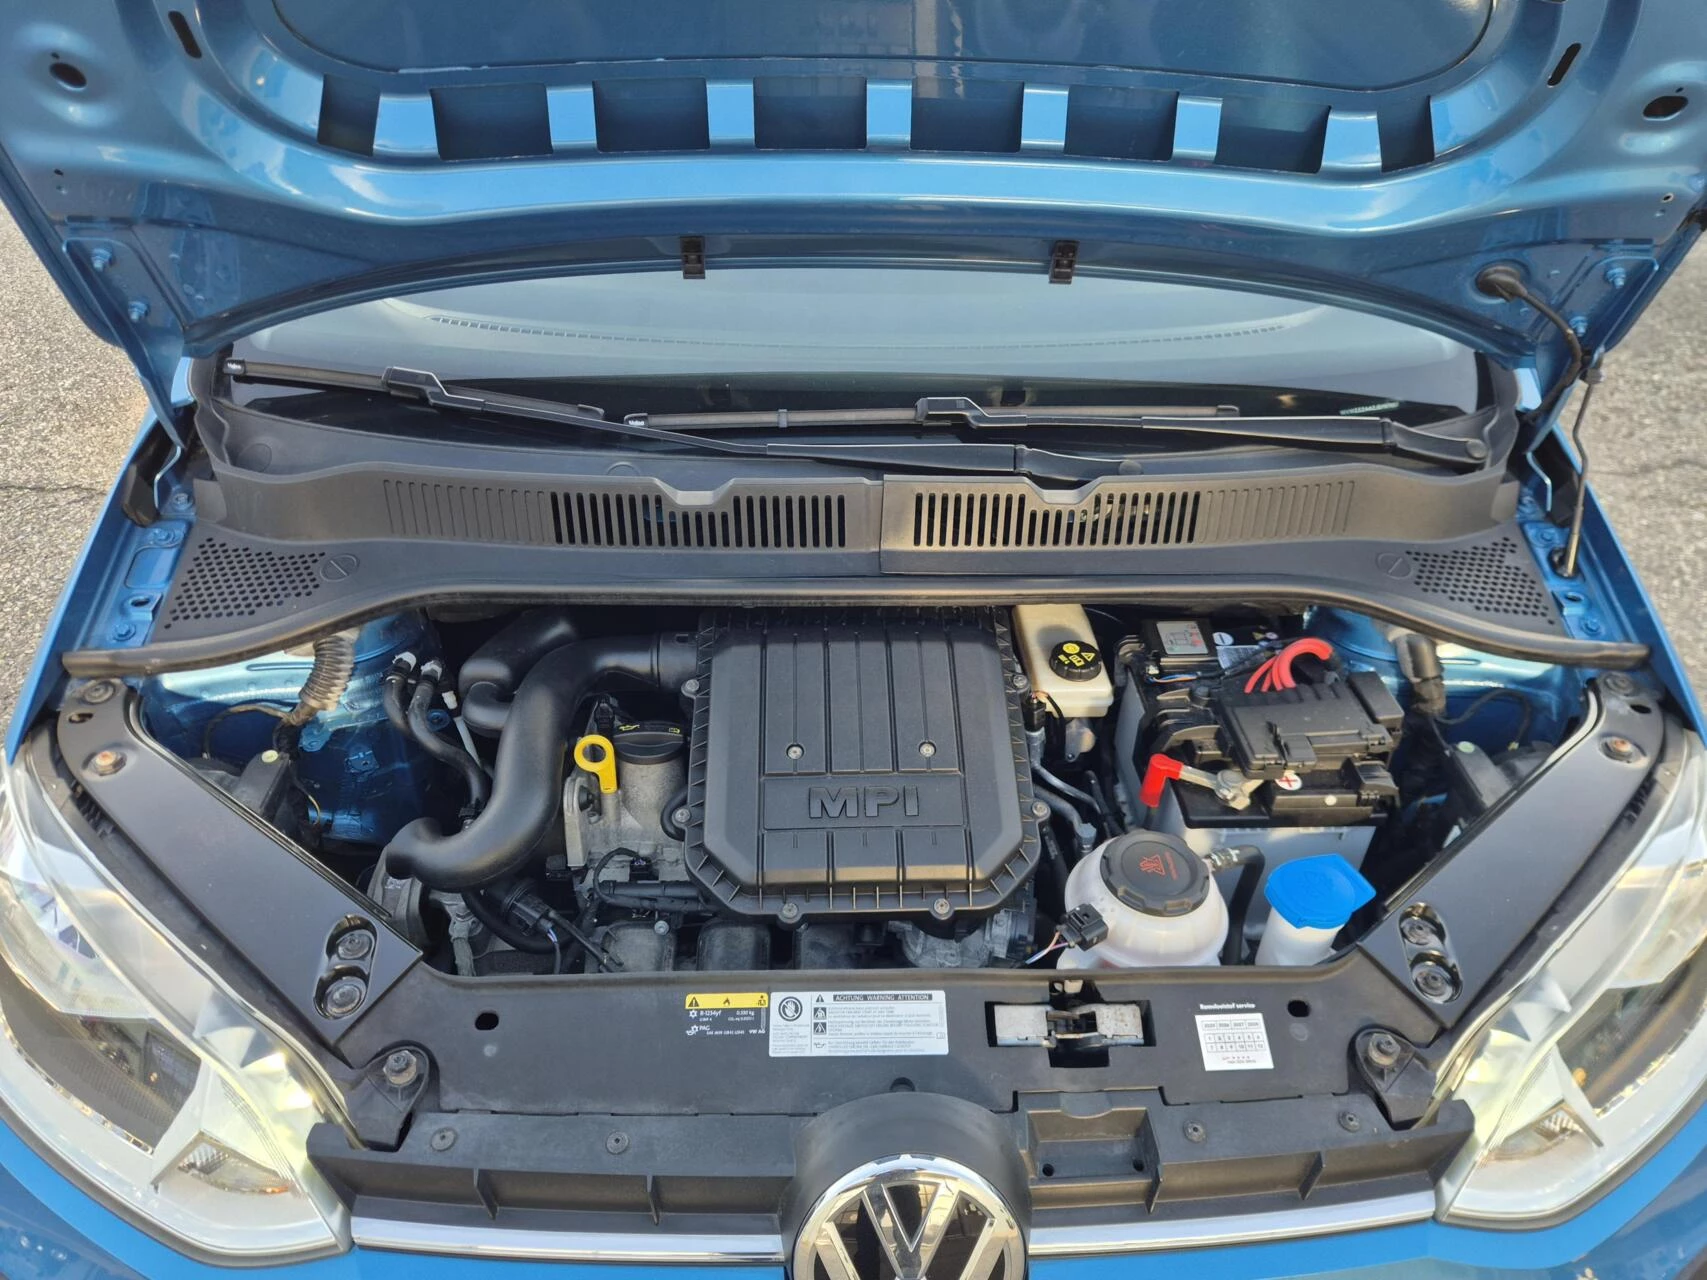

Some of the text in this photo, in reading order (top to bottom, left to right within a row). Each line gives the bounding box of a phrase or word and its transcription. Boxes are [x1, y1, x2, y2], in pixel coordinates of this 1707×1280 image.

[808, 784, 920, 819] MPI
[866, 993, 895, 1001] WARNING
[897, 993, 929, 1001] ATTENTION
